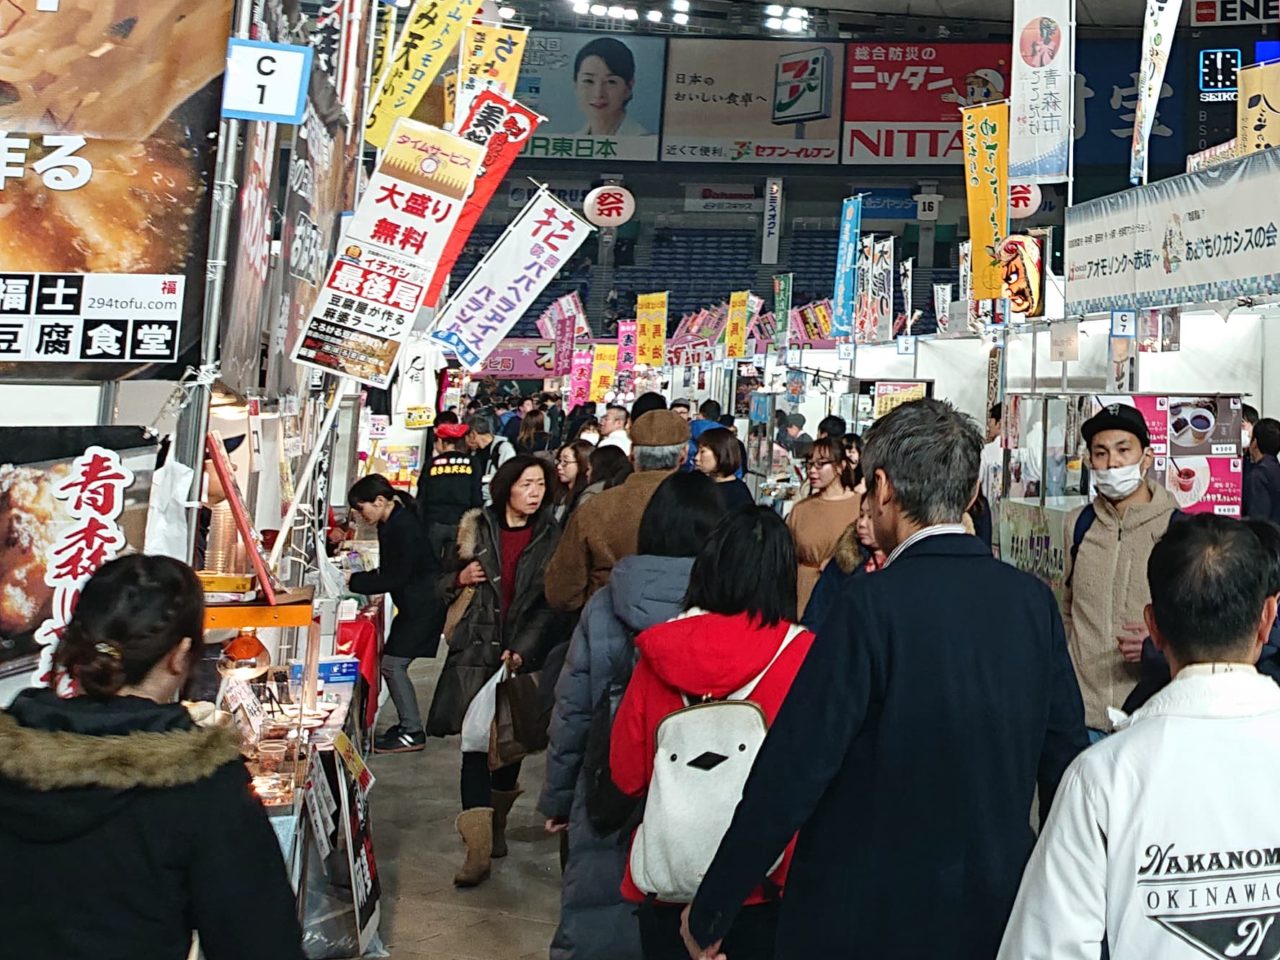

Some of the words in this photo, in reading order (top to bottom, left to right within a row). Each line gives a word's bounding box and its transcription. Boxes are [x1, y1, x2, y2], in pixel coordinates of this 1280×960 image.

[855, 46, 937, 60] 総合防災の
[256, 55, 277, 76] C
[674, 73, 716, 87] 日本の
[851, 66, 953, 91] ニッタン
[257, 84, 267, 105] 1
[673, 92, 768, 107] おいしい食卓へ
[396, 134, 472, 169] タイムサービス
[848, 128, 967, 157] NITTA
[374, 183, 454, 224] 大盛り
[921, 201, 935, 212] 16
[369, 218, 428, 256] 無料
[531, 206, 577, 253] 花
[1184, 223, 1278, 261] あおもりカシスの会
[363, 258, 411, 280] イチオシ
[331, 263, 424, 312] 最後尾
[87, 296, 178, 312] 294tofu.com
[327, 294, 406, 326] 豆腐屋が作る
[322, 307, 402, 338] 麻婆ラーメン
[1120, 314, 1128, 323] C
[1120, 324, 1127, 332] 7
